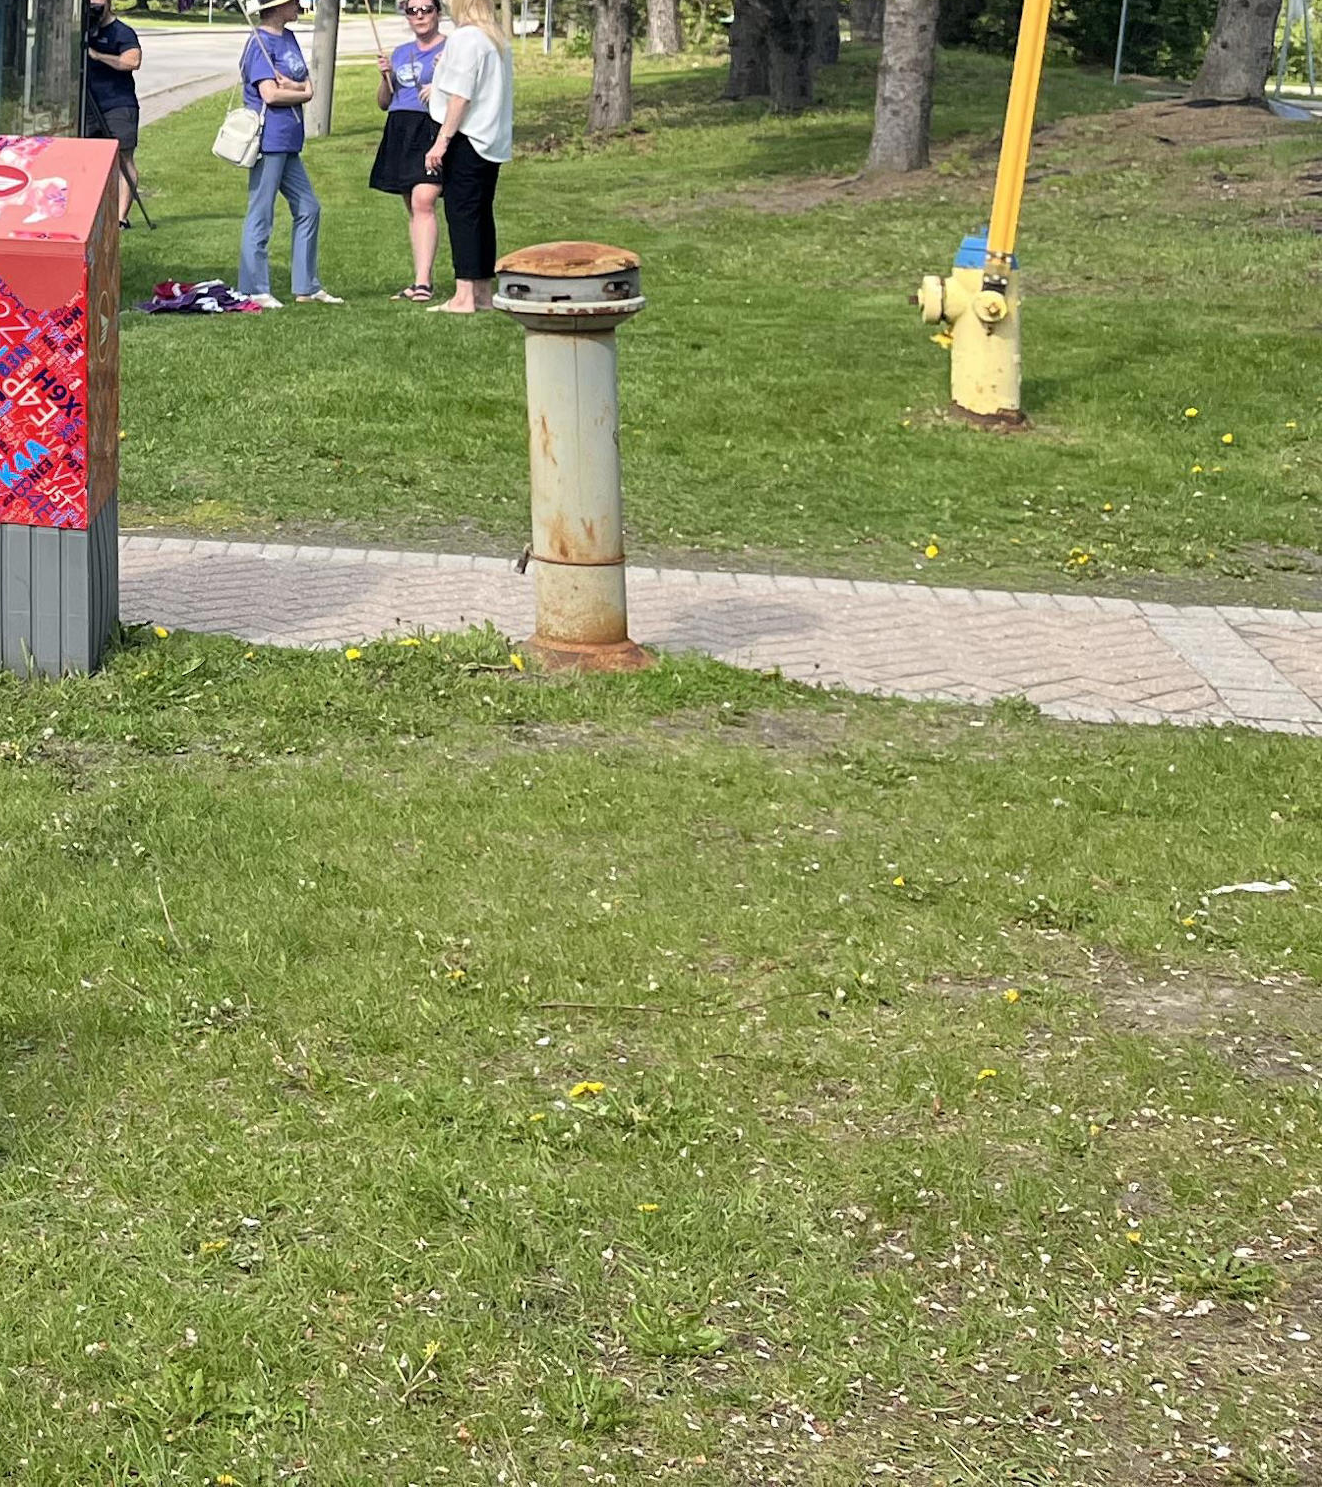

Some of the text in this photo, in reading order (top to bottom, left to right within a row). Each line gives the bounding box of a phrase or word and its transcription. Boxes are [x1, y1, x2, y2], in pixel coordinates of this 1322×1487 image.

[2, 377, 59, 427] E4P
[33, 368, 82, 417] H9X
[44, 486, 72, 508] J5T
[48, 463, 87, 503] V7J
